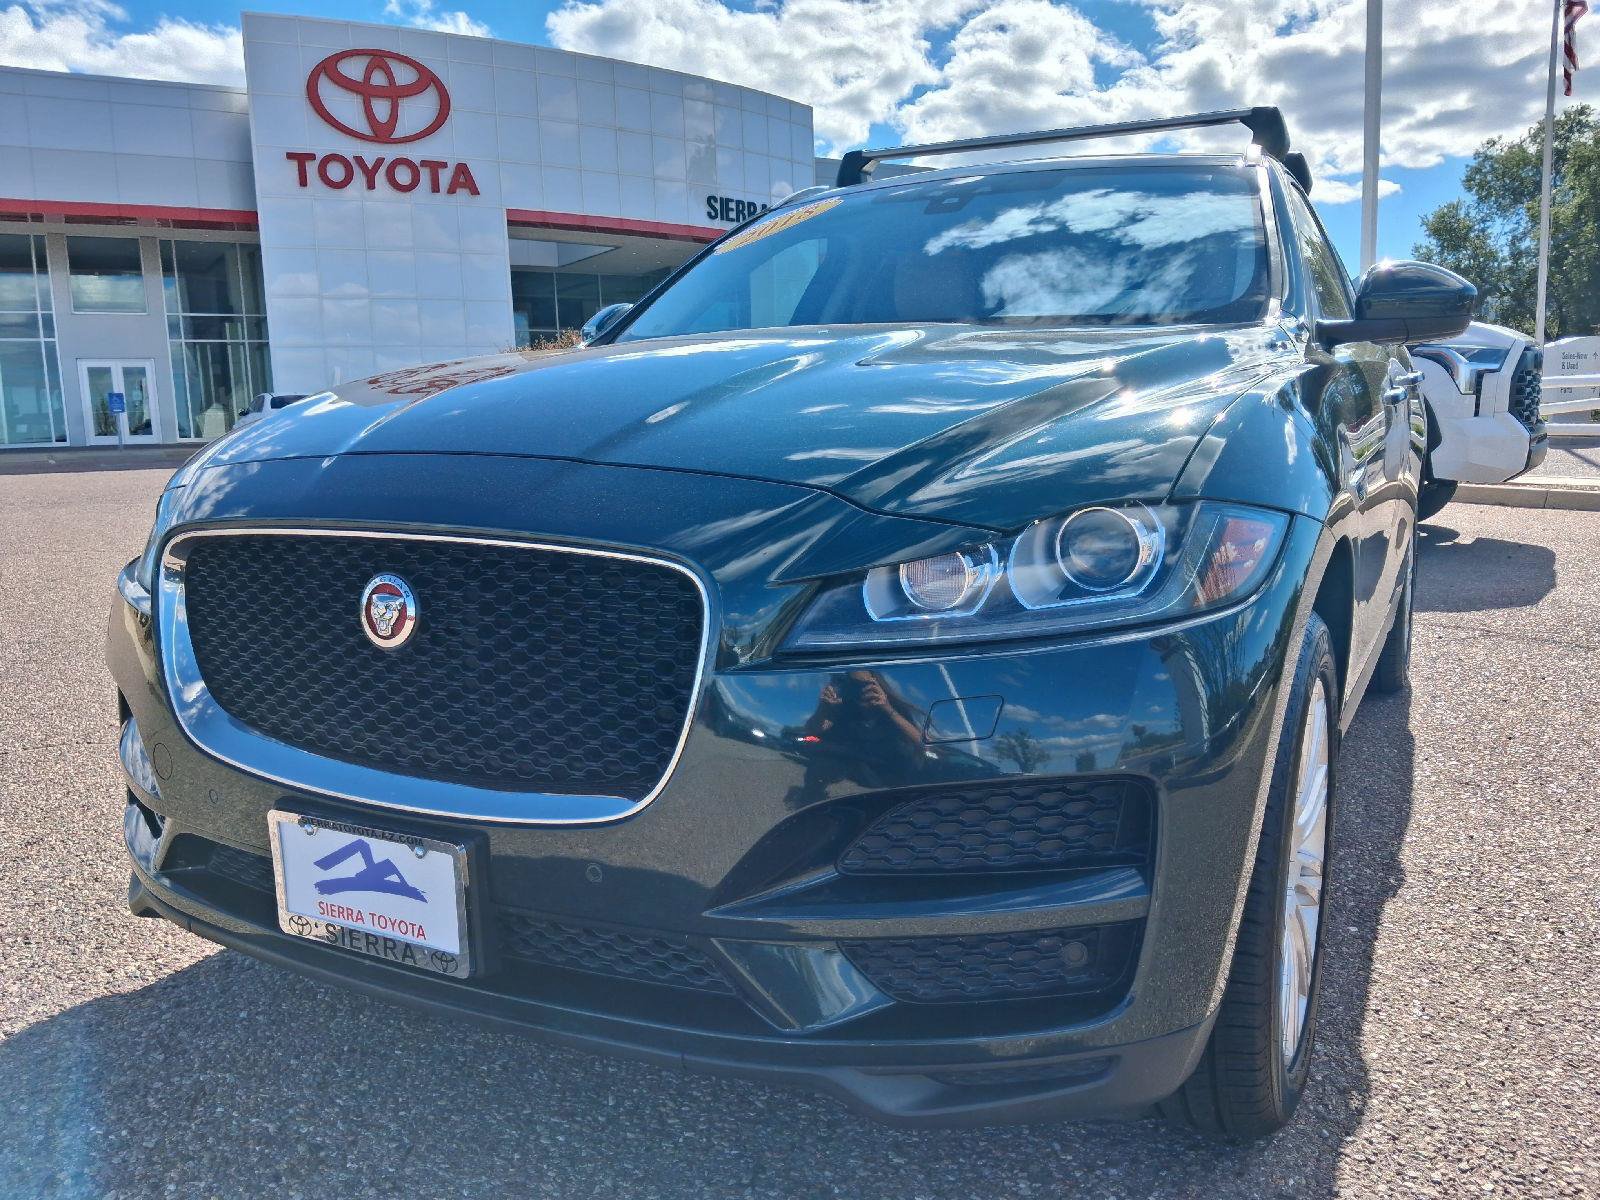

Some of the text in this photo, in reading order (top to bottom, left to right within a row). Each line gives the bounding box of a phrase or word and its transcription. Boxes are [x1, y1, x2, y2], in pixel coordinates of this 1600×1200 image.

[286, 152, 480, 195] TOYOTA
[1566, 361, 1579, 370] Used
[318, 901, 426, 940] SIERRA TOYOTA
[325, 922, 417, 965] SIERRA
